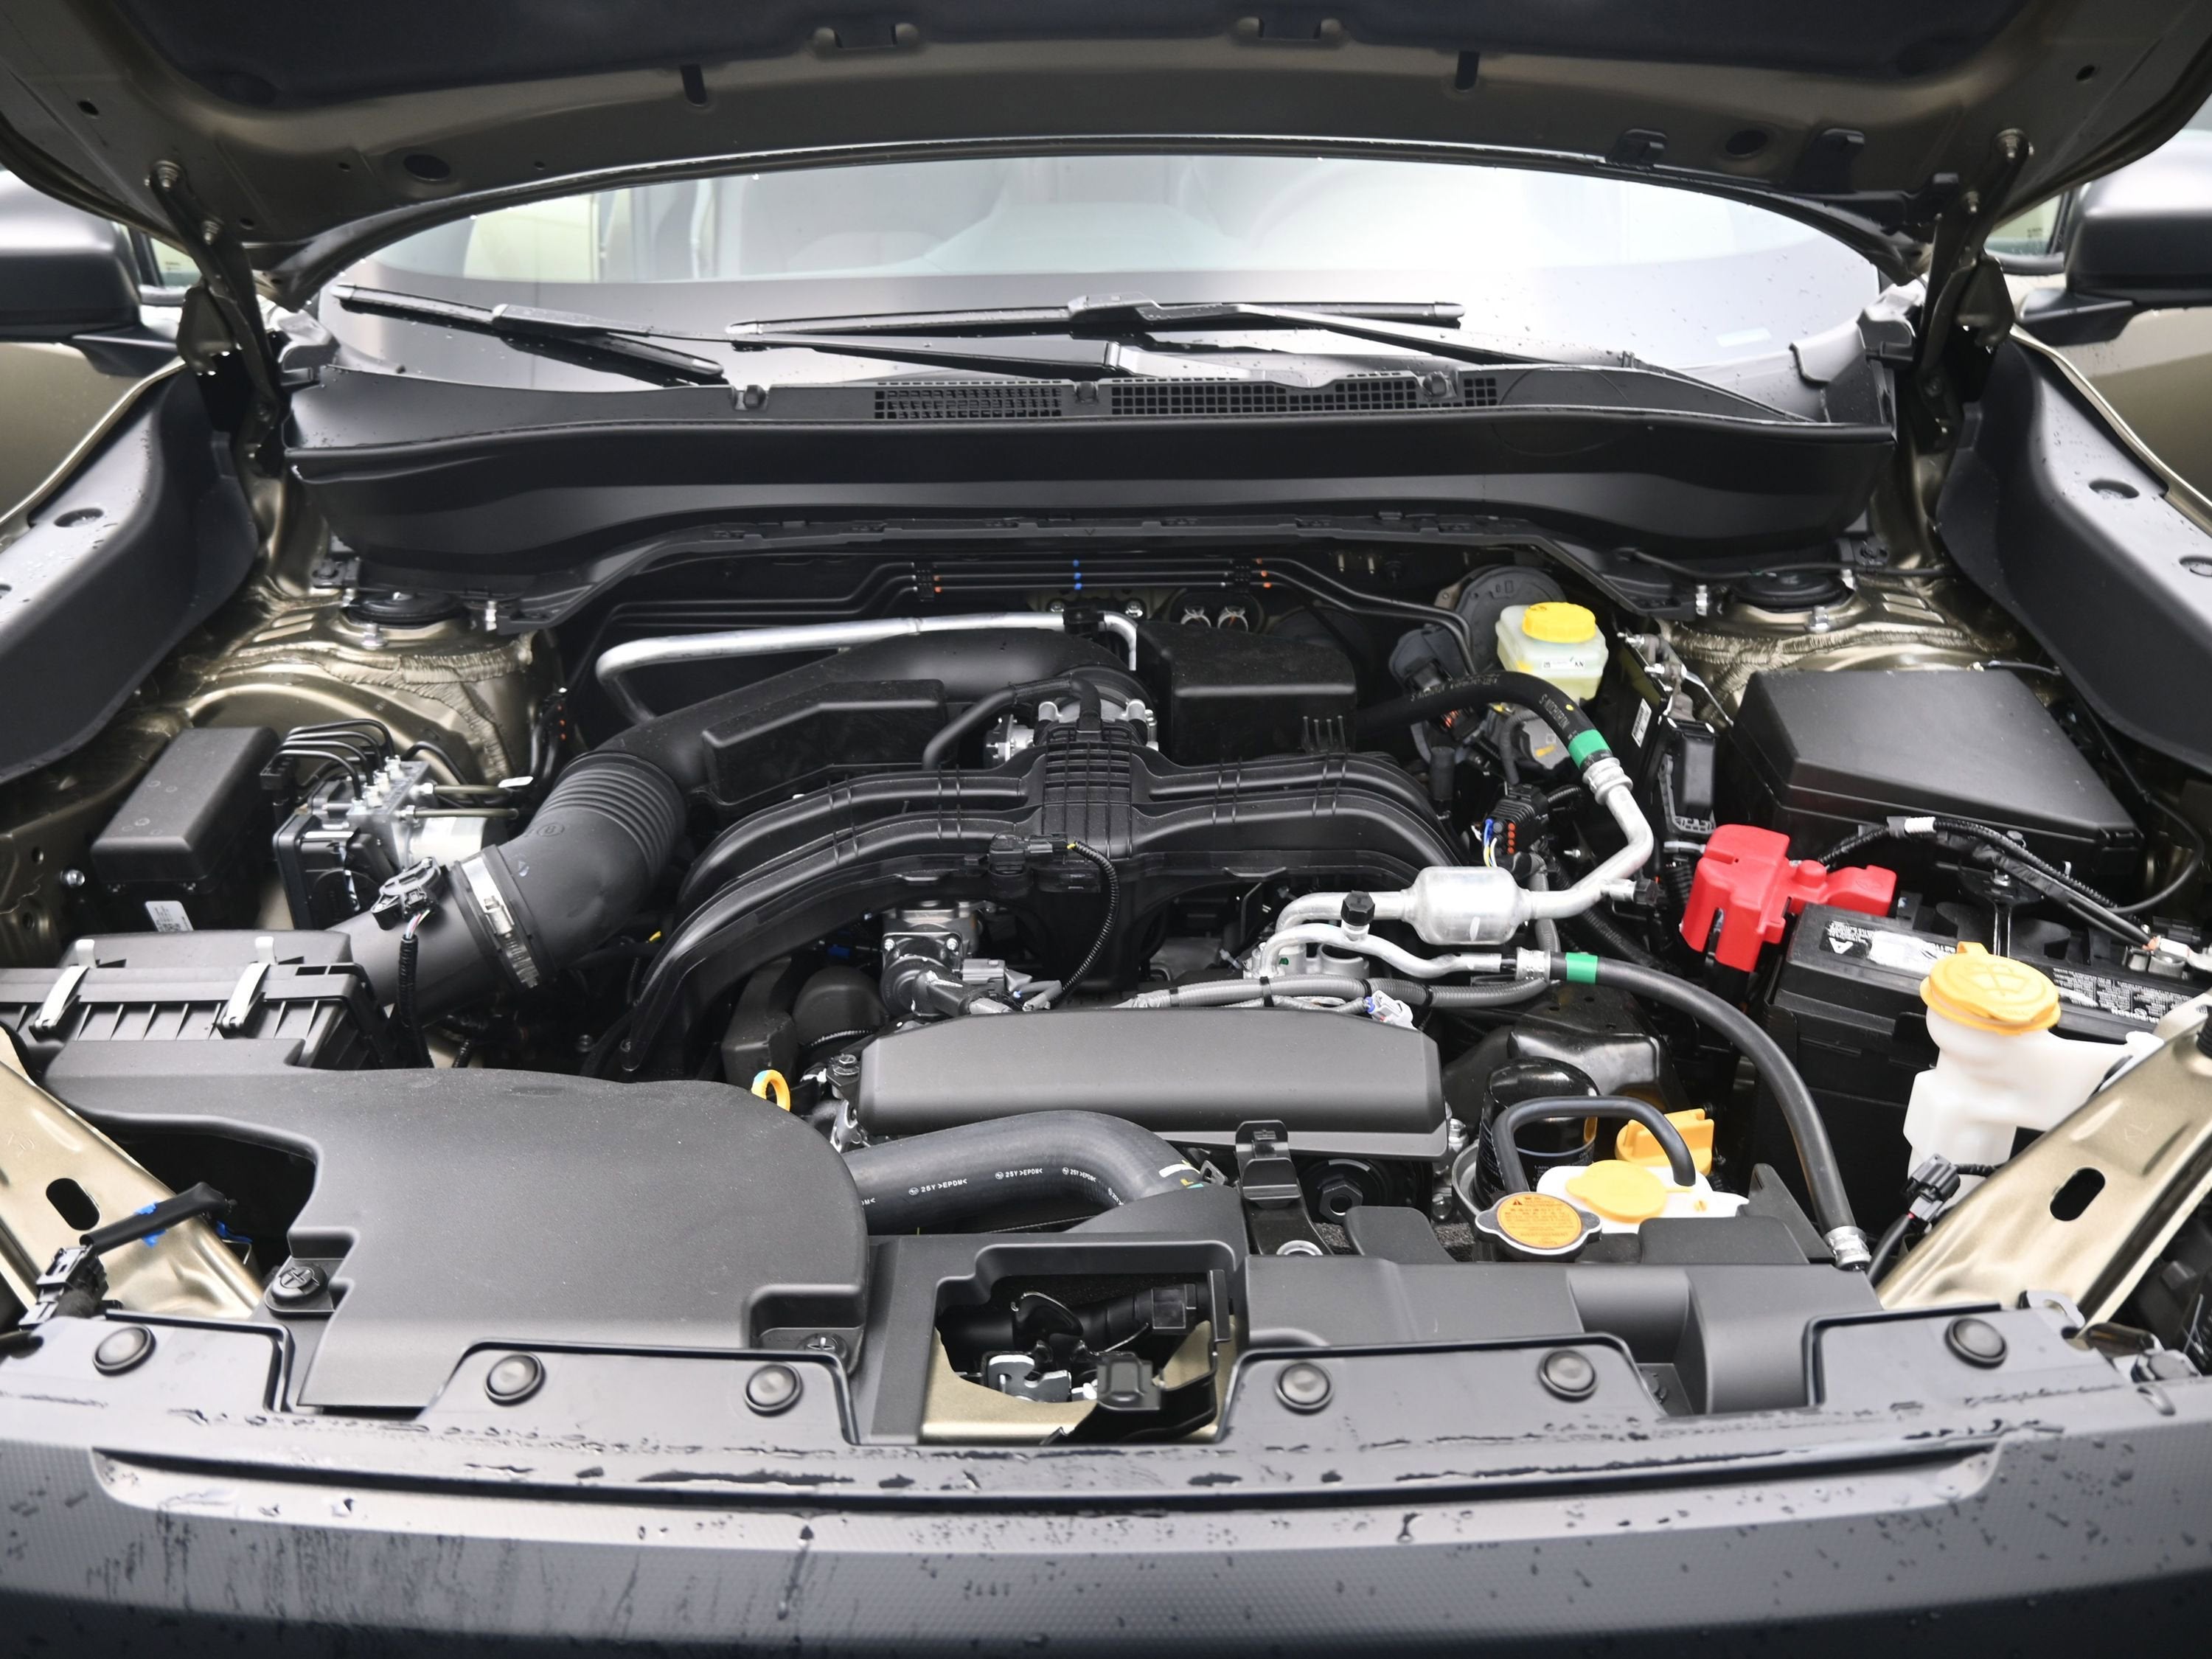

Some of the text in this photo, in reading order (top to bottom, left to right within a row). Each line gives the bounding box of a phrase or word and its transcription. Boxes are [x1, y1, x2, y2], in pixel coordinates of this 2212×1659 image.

[1005, 1170, 1018, 1178] 25Y
[920, 1178, 967, 1193] 25Y >EPDM<
